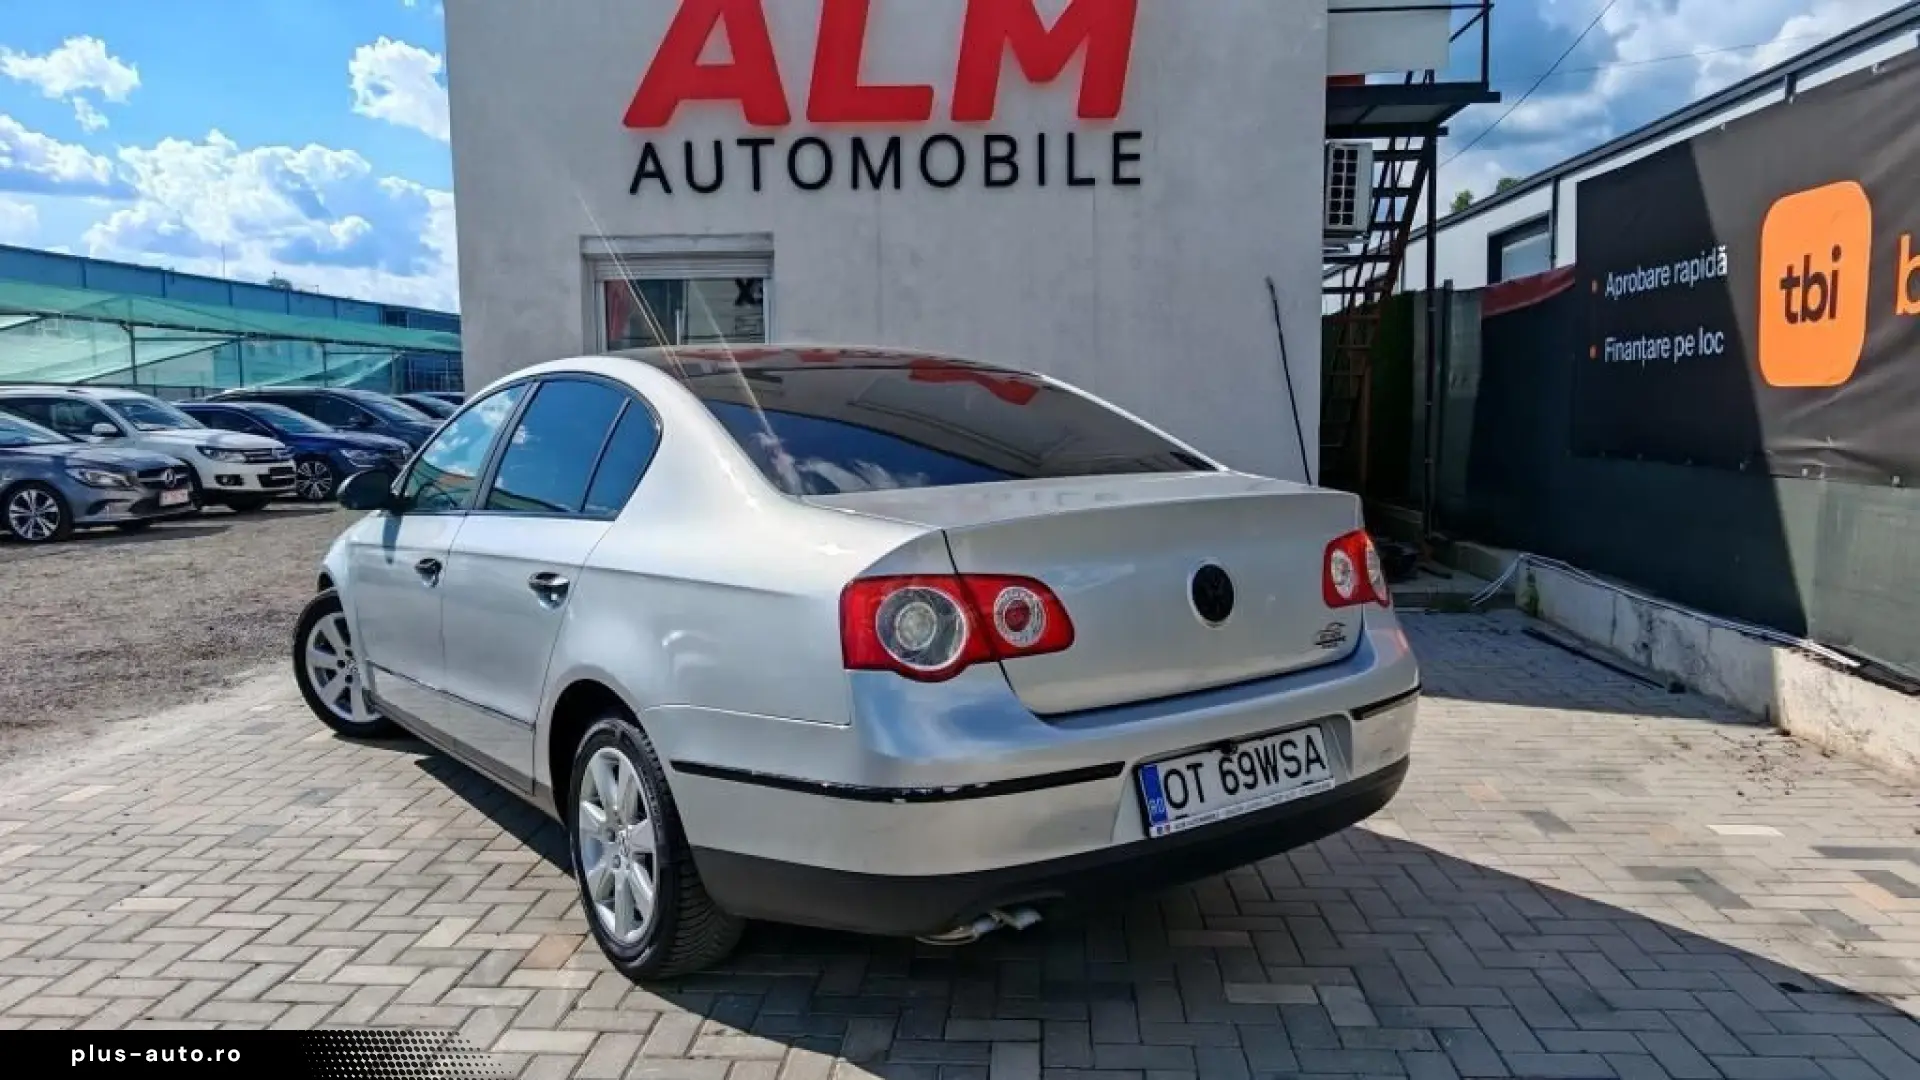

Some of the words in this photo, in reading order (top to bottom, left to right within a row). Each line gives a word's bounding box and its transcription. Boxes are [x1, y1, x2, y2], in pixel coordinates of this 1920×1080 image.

[622, 0, 1138, 128] ALM
[629, 130, 1143, 195] AUTOMOBILE
[1604, 264, 1671, 300] Aprobare
[1673, 245, 1728, 287] rapidă
[1779, 244, 1842, 325] tbi
[1604, 331, 1670, 366] Finanțare
[1673, 334, 1695, 364] pe
[1698, 326, 1724, 356] loc
[1163, 762, 1205, 810] OT
[1218, 734, 1326, 796] 69WSA
